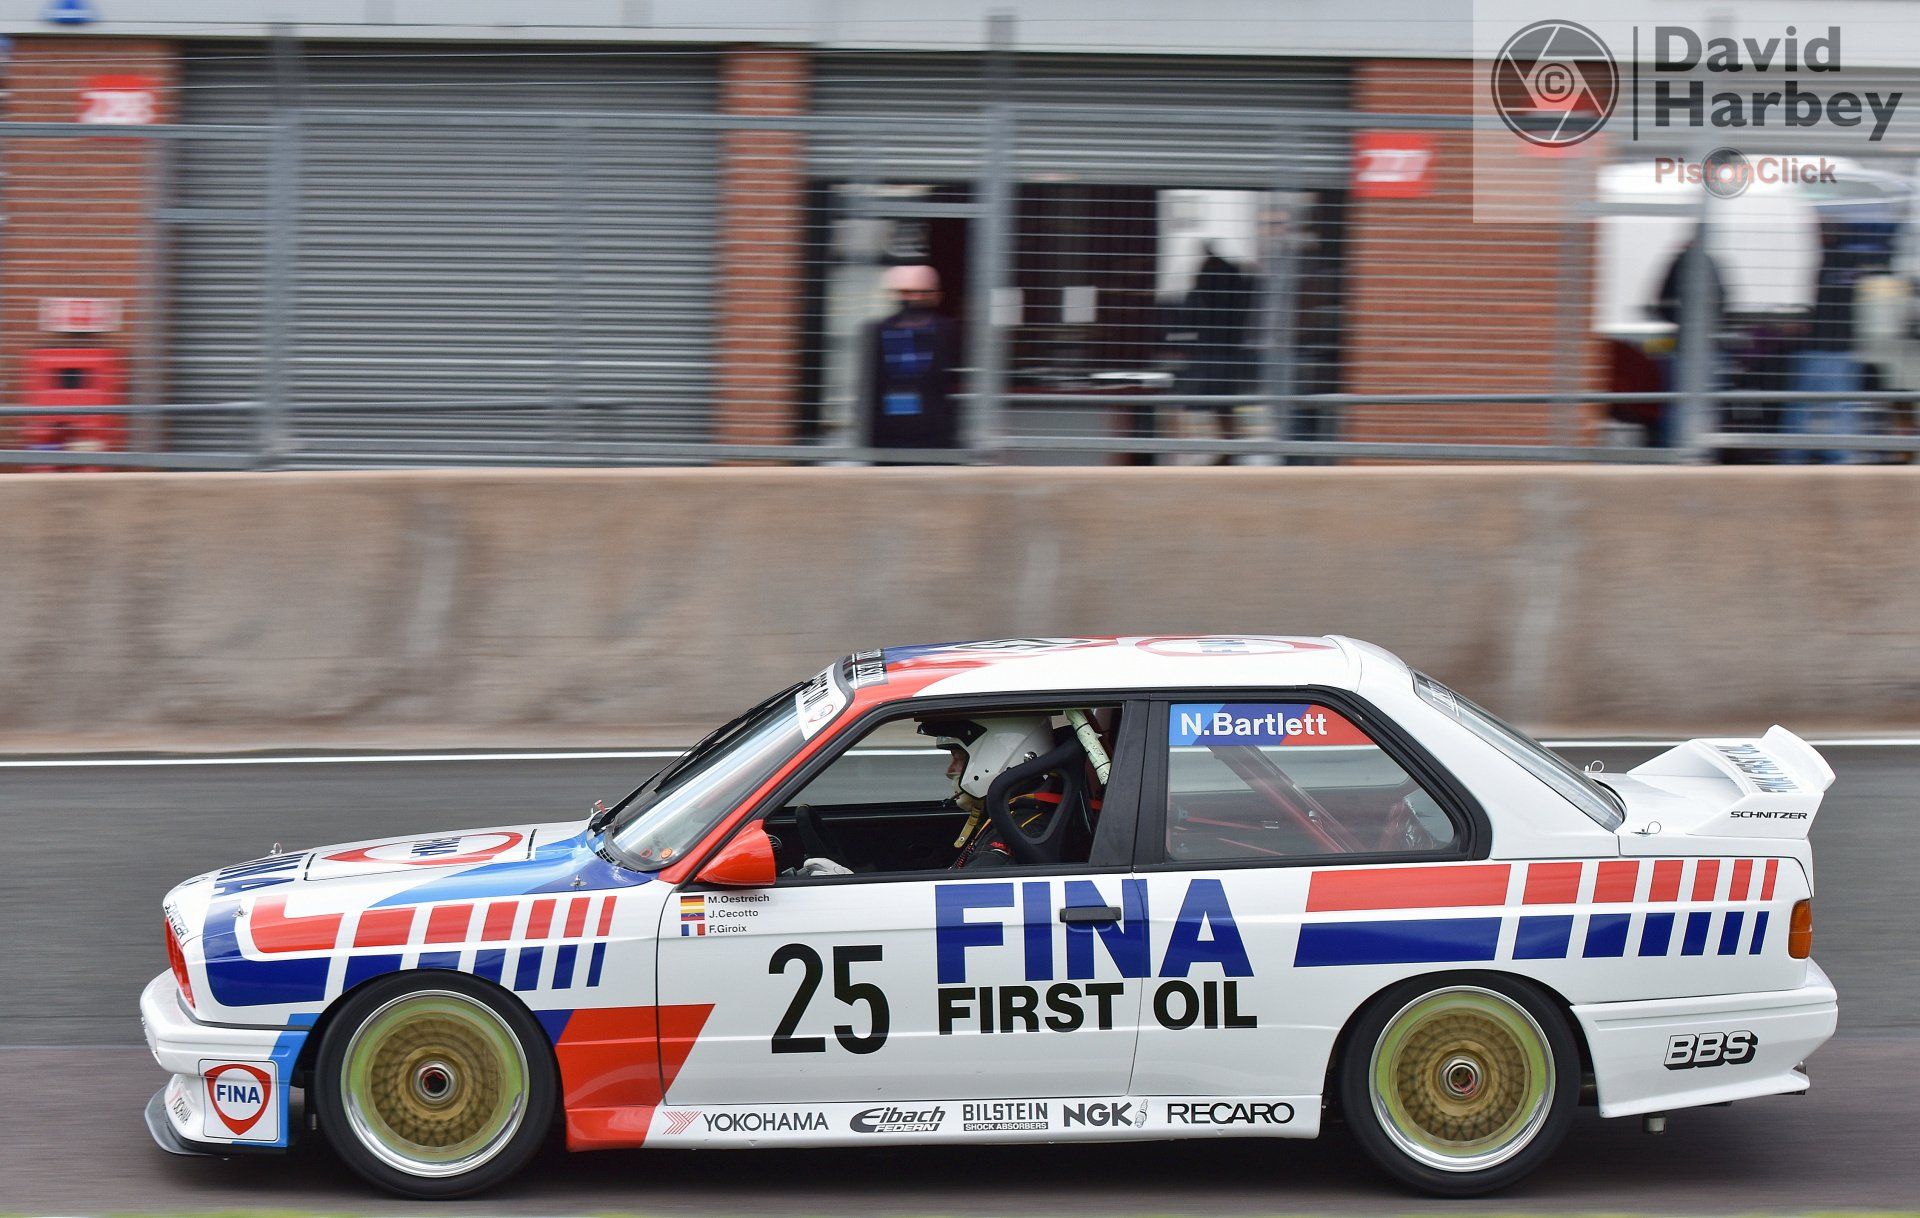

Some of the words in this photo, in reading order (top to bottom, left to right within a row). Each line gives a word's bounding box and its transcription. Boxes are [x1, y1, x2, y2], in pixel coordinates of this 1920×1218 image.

[1180, 712, 1328, 736] N.Bartlett
[1730, 810, 1808, 820] SCHNITZER
[708, 893, 770, 904] M.Oestreich
[708, 909, 759, 919] J.Cecotto
[708, 923, 747, 933] F.Giroix
[935, 878, 1255, 984] FINA
[767, 942, 890, 1055] 25
[938, 982, 1125, 1036] FIRST
[1152, 980, 1258, 1031] OIL
[1663, 1029, 1759, 1070] BBS
[216, 1083, 261, 1104] FINA
[703, 1112, 829, 1132] YOKOHAMA
[849, 1106, 946, 1133] Eibach
[962, 1102, 1048, 1121] BILSTEIN
[1063, 1101, 1134, 1128] NGK
[1166, 1101, 1295, 1124] RECARO
[874, 1123, 938, 1133] FEDERN
[965, 1123, 995, 1131] SHOCK
[996, 1122, 1047, 1130] ABSORBERS
